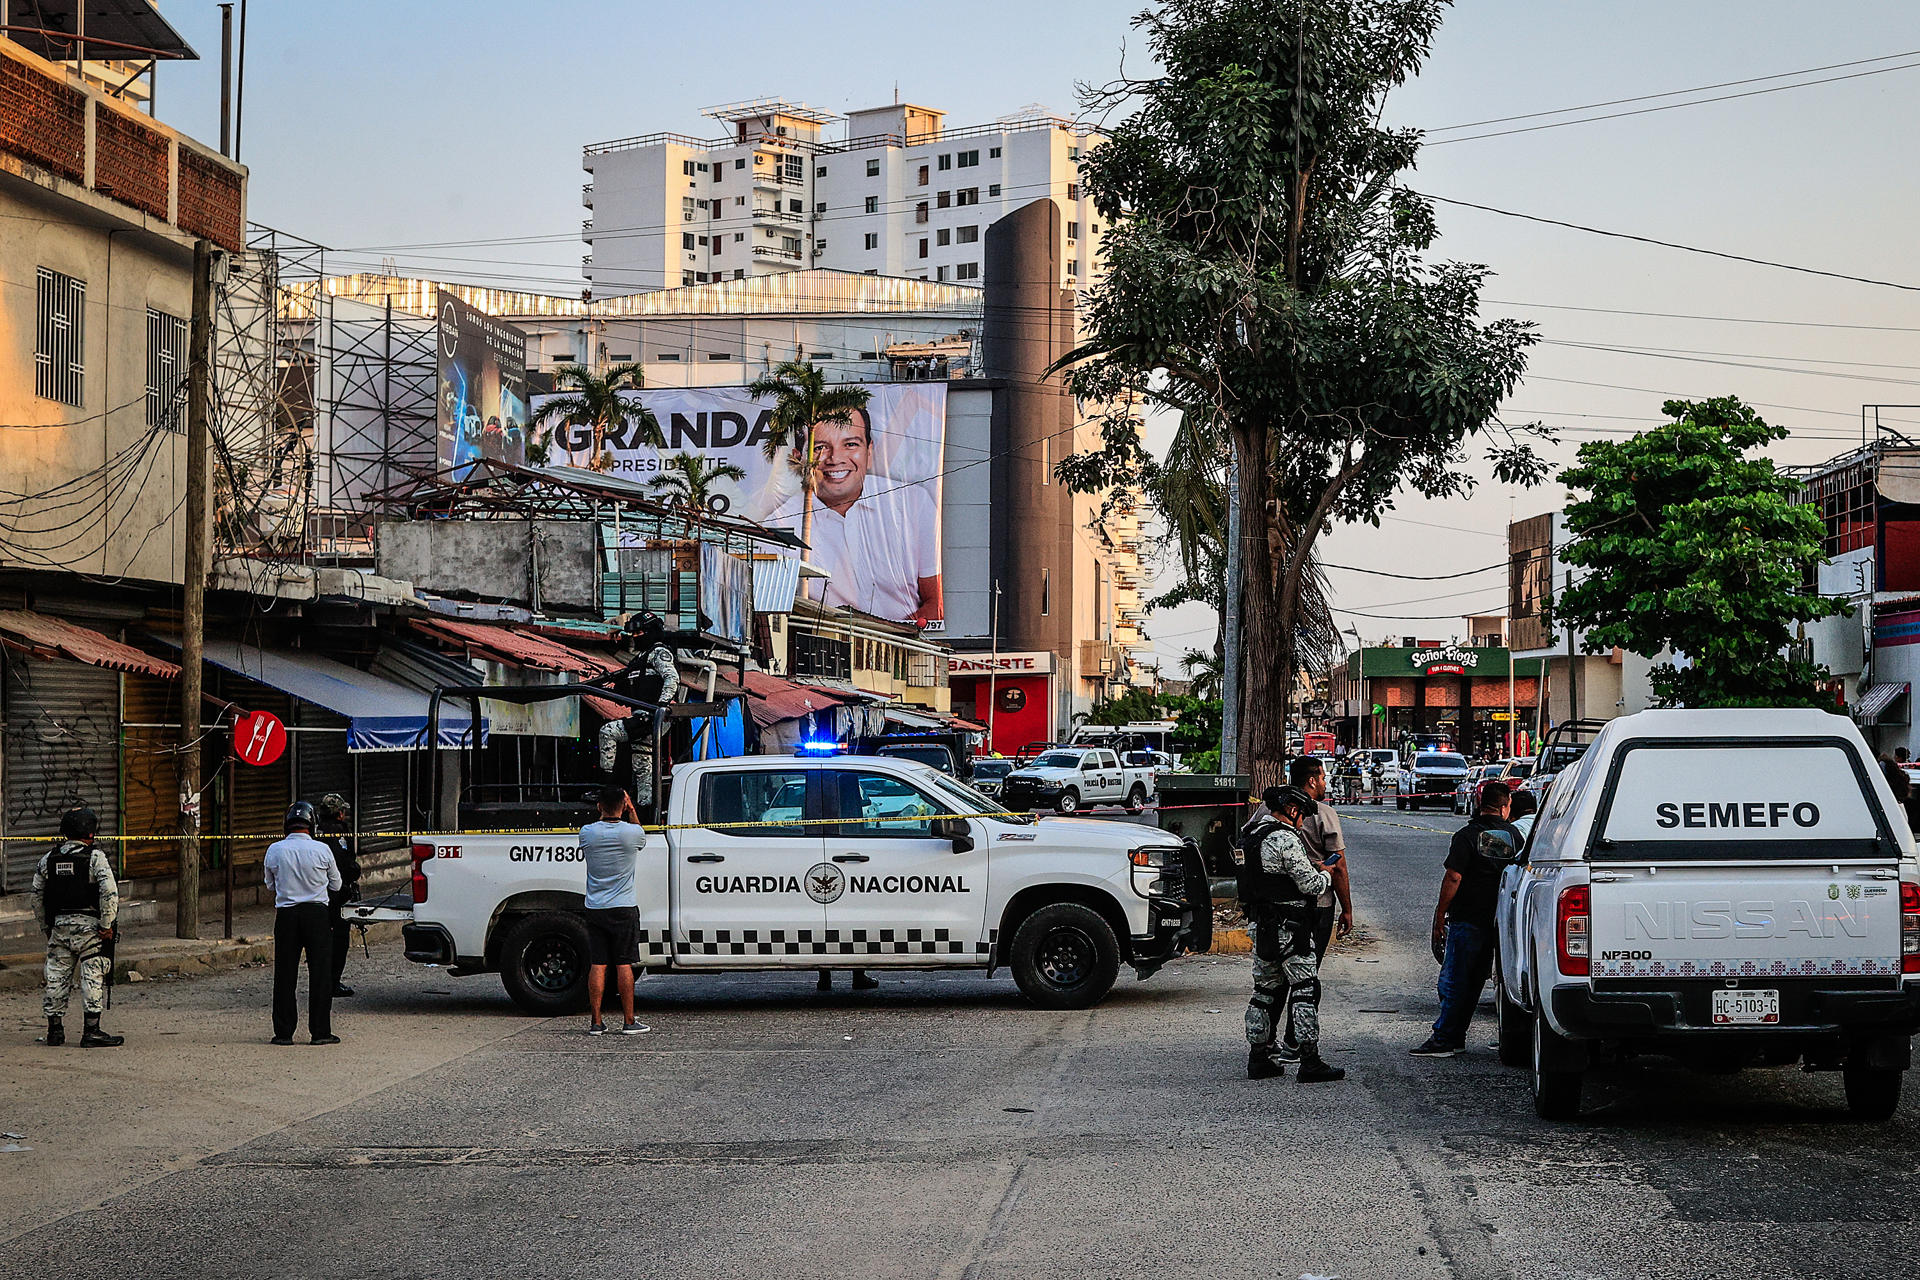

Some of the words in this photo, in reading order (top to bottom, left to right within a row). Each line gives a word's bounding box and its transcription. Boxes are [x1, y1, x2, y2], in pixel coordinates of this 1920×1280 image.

[441, 320, 459, 338] NISSAN
[466, 311, 482, 327] SOMOS
[484, 321, 493, 333] LOS
[494, 326, 524, 347] INGENIEROS
[486, 335, 493, 346] DE
[494, 339, 500, 349] LA
[1411, 649, 1446, 668] Señor
[1445, 645, 1479, 668] Frog's
[1656, 802, 1820, 828] SEMEFO
[438, 847, 462, 857] 911
[696, 876, 801, 894] GUARDIA
[850, 876, 970, 893] NACIONAL
[1624, 900, 1868, 940] NISSAN
[1602, 951, 1652, 960] NP300
[1716, 999, 1777, 1013] HC-5103-G
